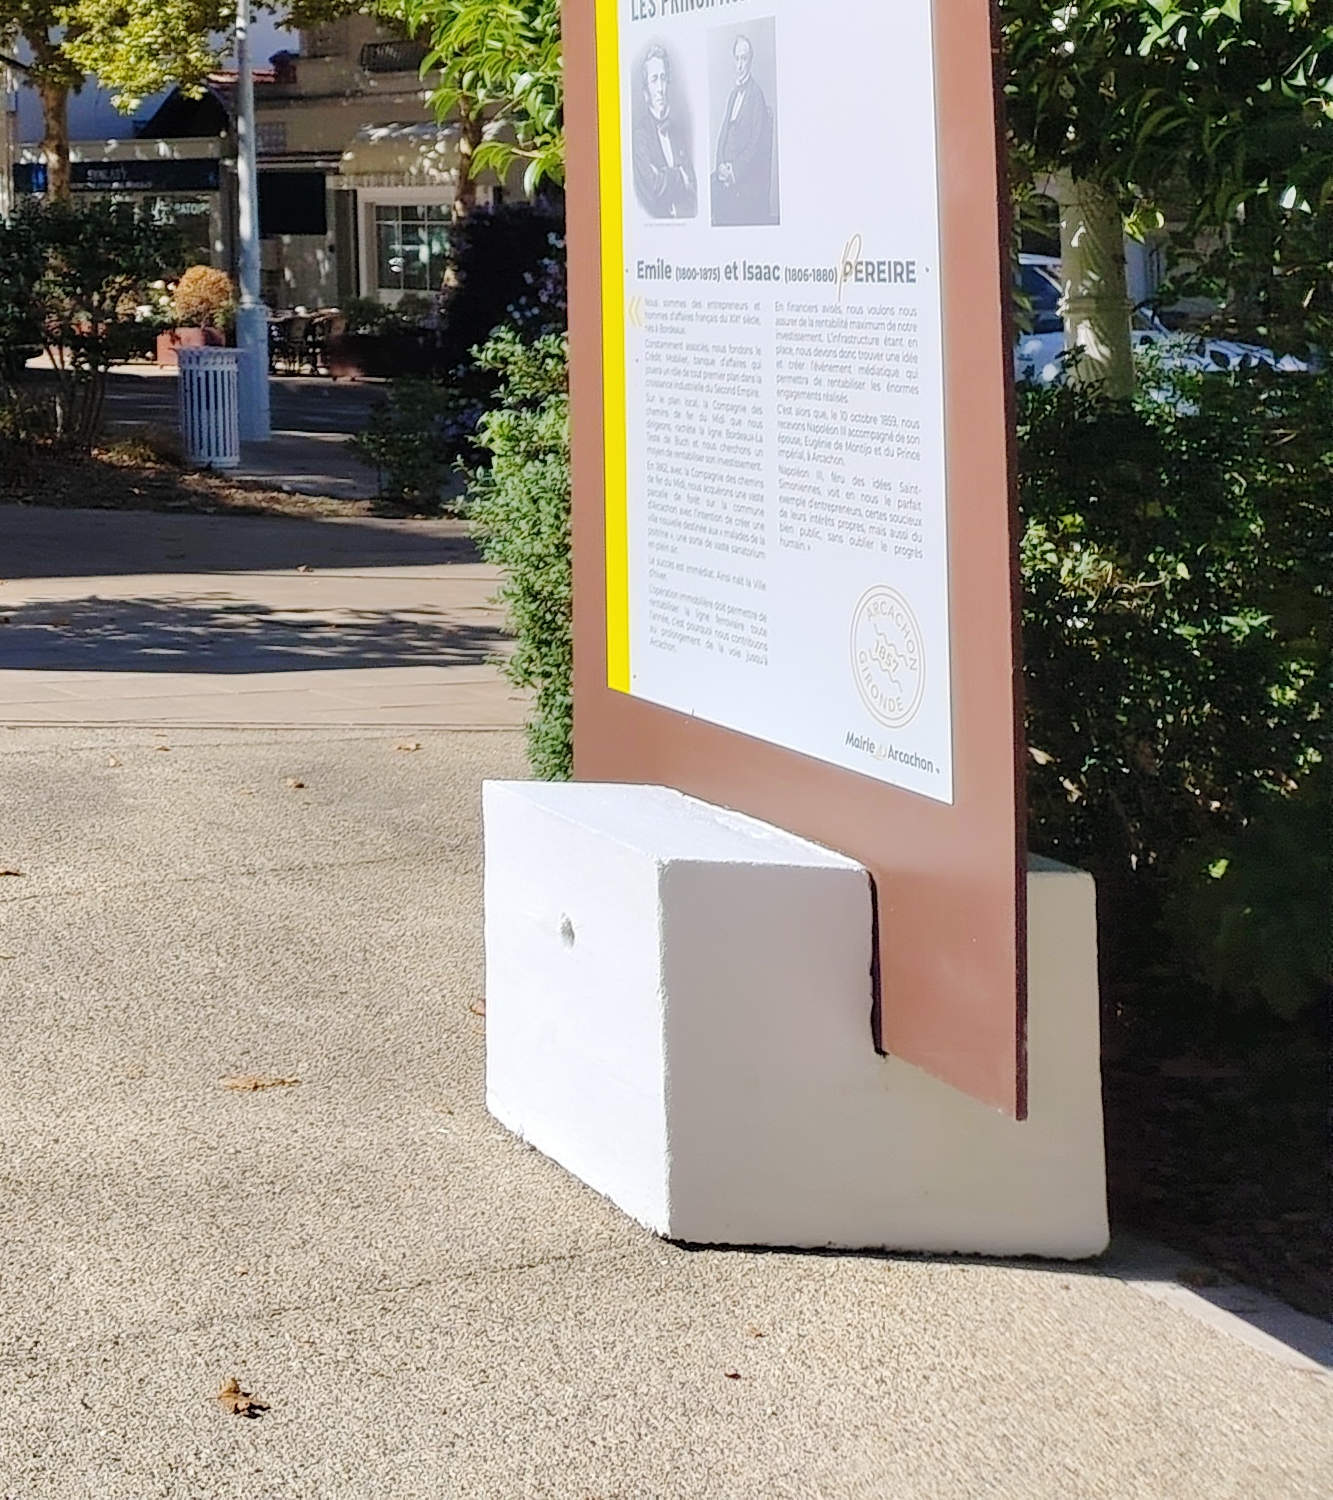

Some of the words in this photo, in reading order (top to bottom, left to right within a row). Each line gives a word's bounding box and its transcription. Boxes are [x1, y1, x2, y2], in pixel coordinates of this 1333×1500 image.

[637, 258, 672, 280] Emile
[675, 266, 721, 283] (1800-1875)
[724, 260, 739, 280] et
[743, 260, 781, 282] Isaac
[785, 266, 837, 284] (1806-1880)
[843, 260, 917, 284] PEREIRE
[865, 601, 917, 672] ARCACHON
[874, 639, 899, 674] 1857
[859, 650, 904, 713] GIRONDE
[845, 730, 875, 754] Mairie
[888, 744, 933, 774] Arcachon
